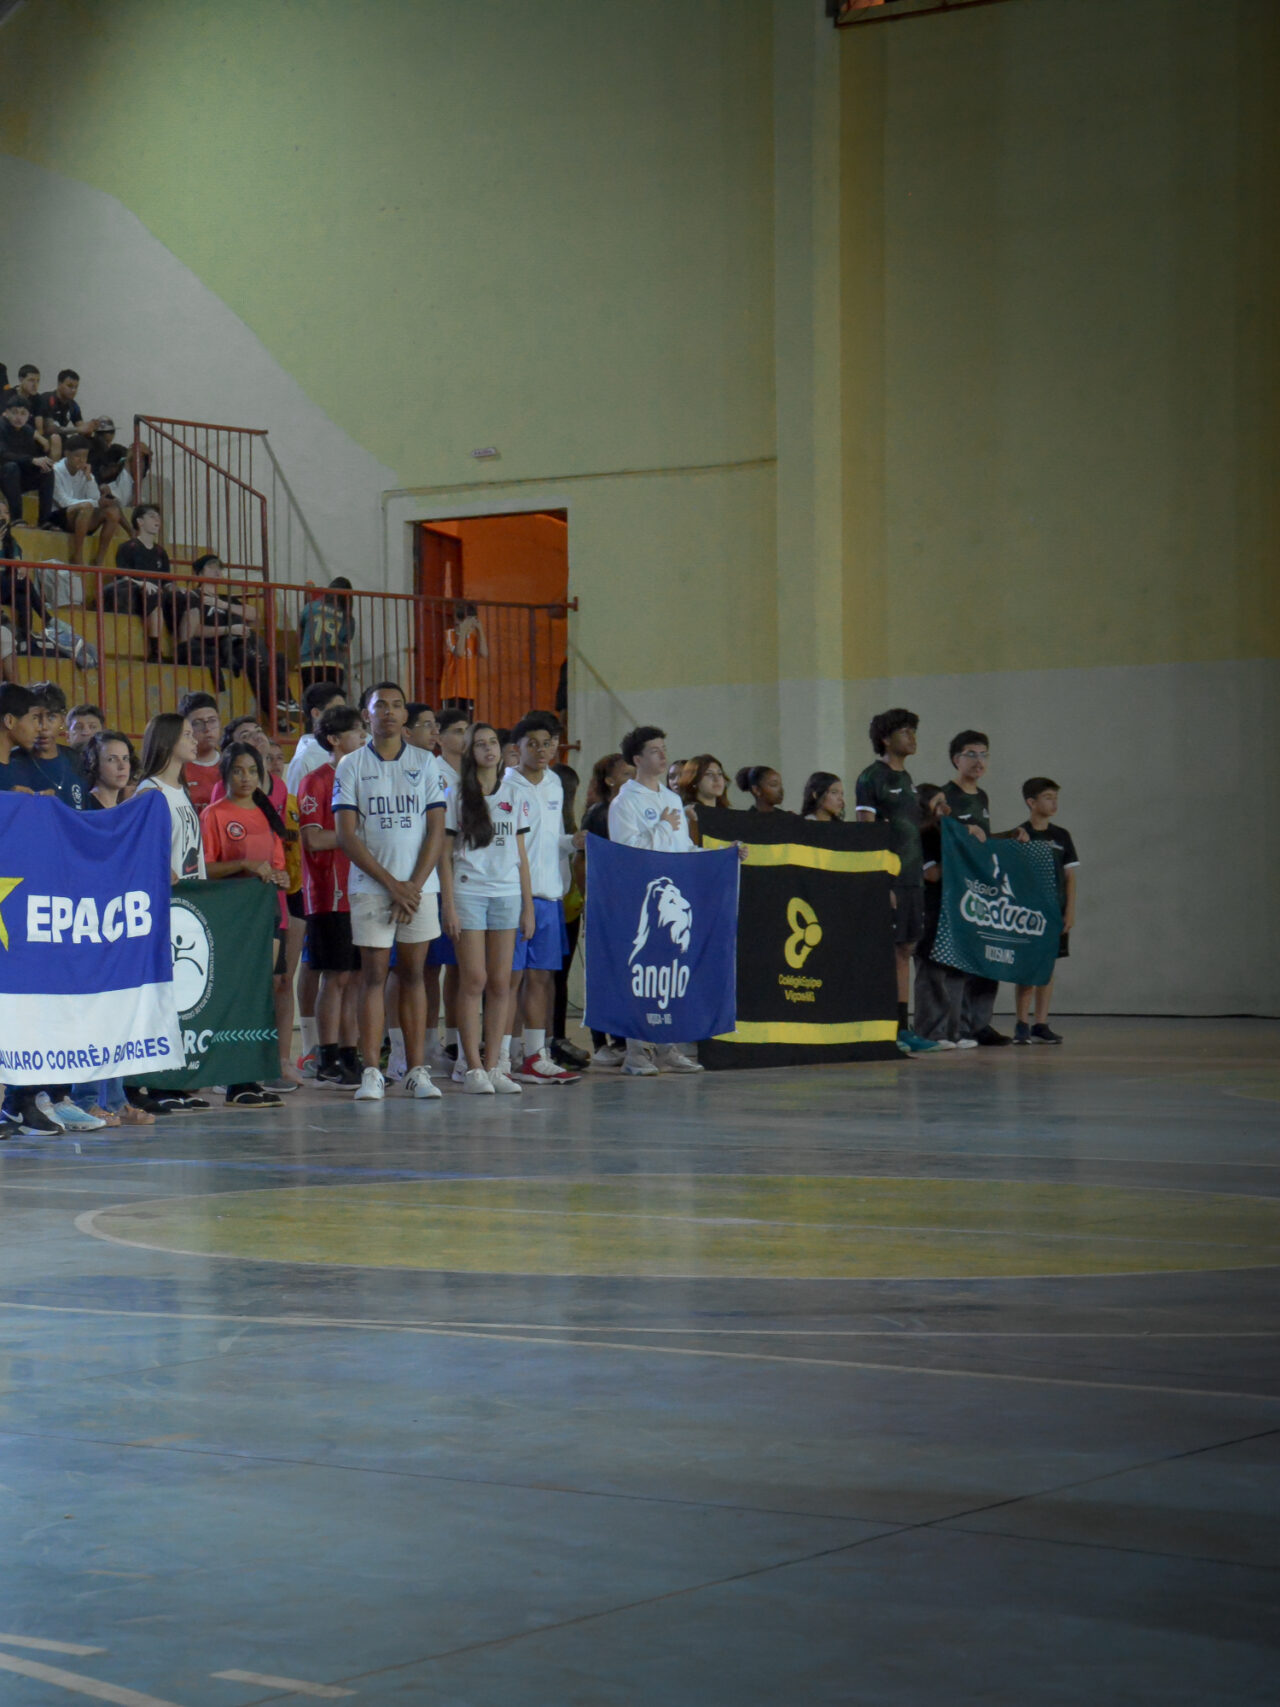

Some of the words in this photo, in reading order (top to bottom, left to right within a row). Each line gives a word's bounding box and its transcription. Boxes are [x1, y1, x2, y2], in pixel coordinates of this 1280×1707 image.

[368, 794, 420, 816] COLUNI
[26, 890, 153, 944] EPACB
[631, 958, 690, 1010] anglo
[182, 1029, 214, 1055] RC
[46, 1043, 111, 1070] CORRÊA
